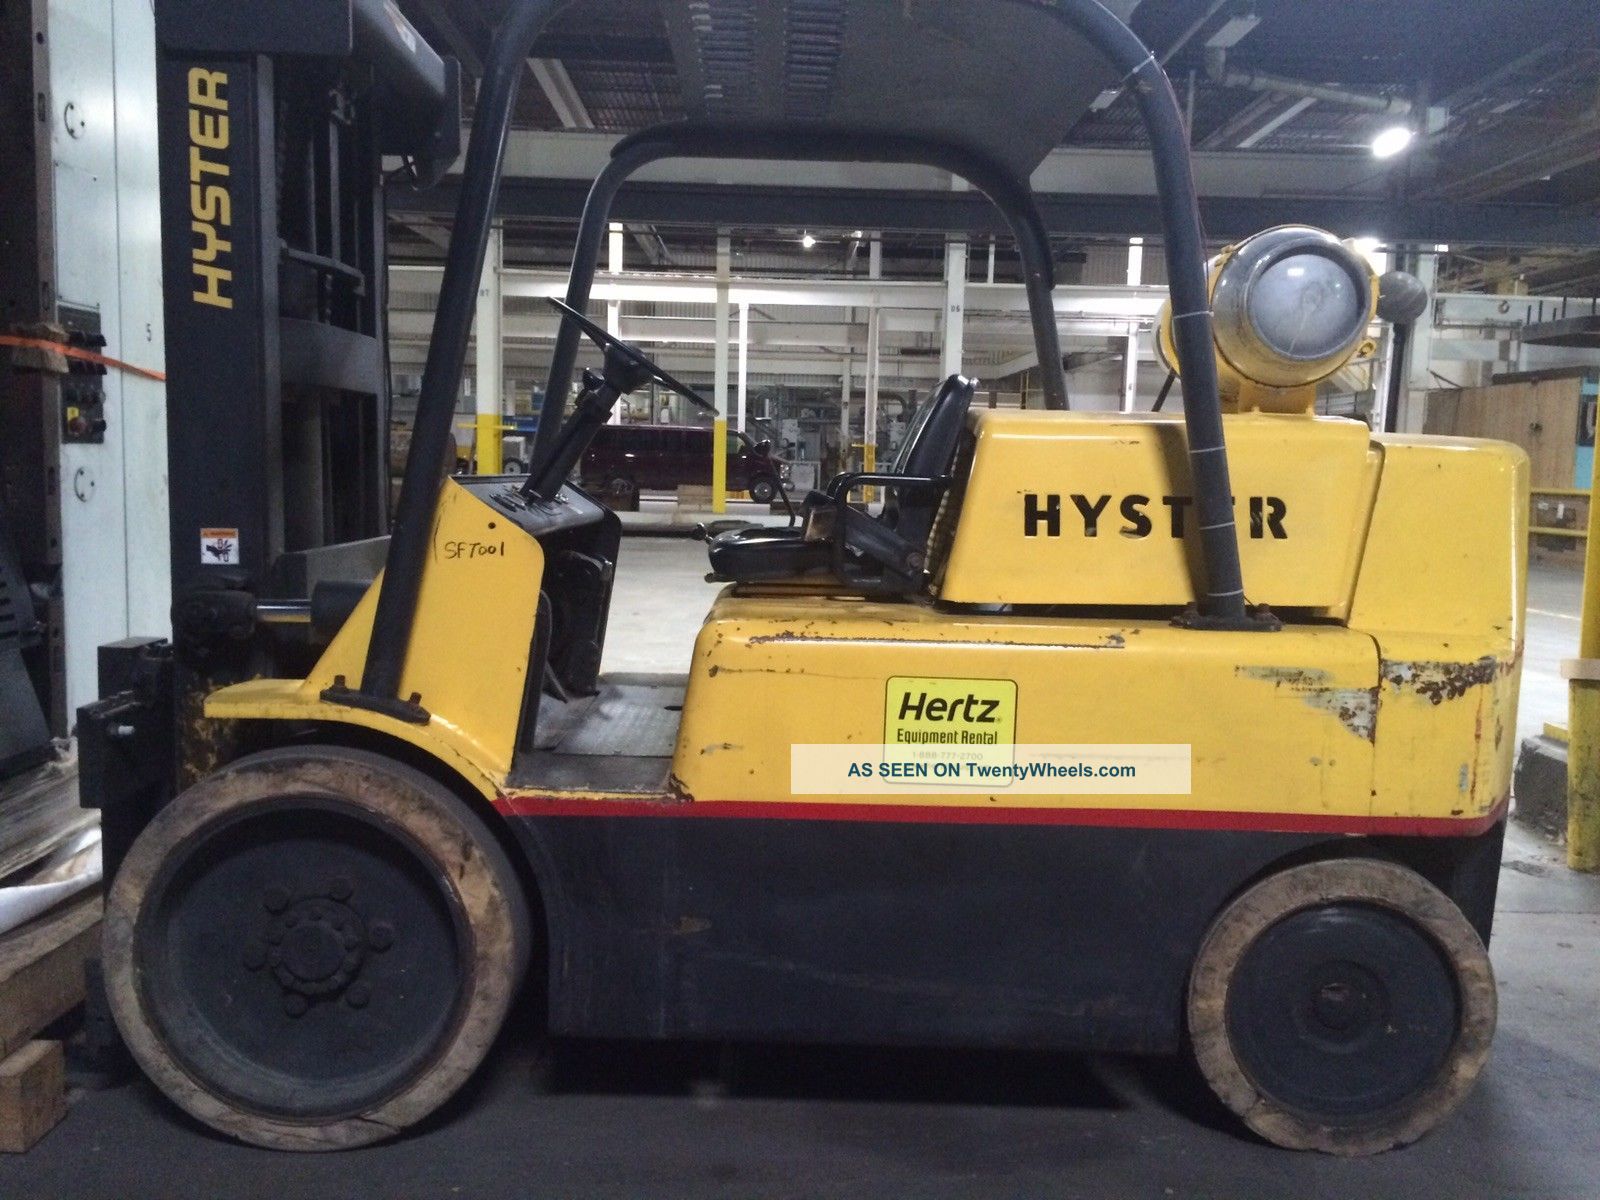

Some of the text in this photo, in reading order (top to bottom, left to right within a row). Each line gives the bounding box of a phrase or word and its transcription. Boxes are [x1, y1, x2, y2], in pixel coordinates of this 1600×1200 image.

[188, 67, 233, 309] HYSTER
[1024, 494, 1288, 539] HYSTR
[898, 692, 1000, 723] Hertz
[897, 728, 998, 745] Equipment Rental
